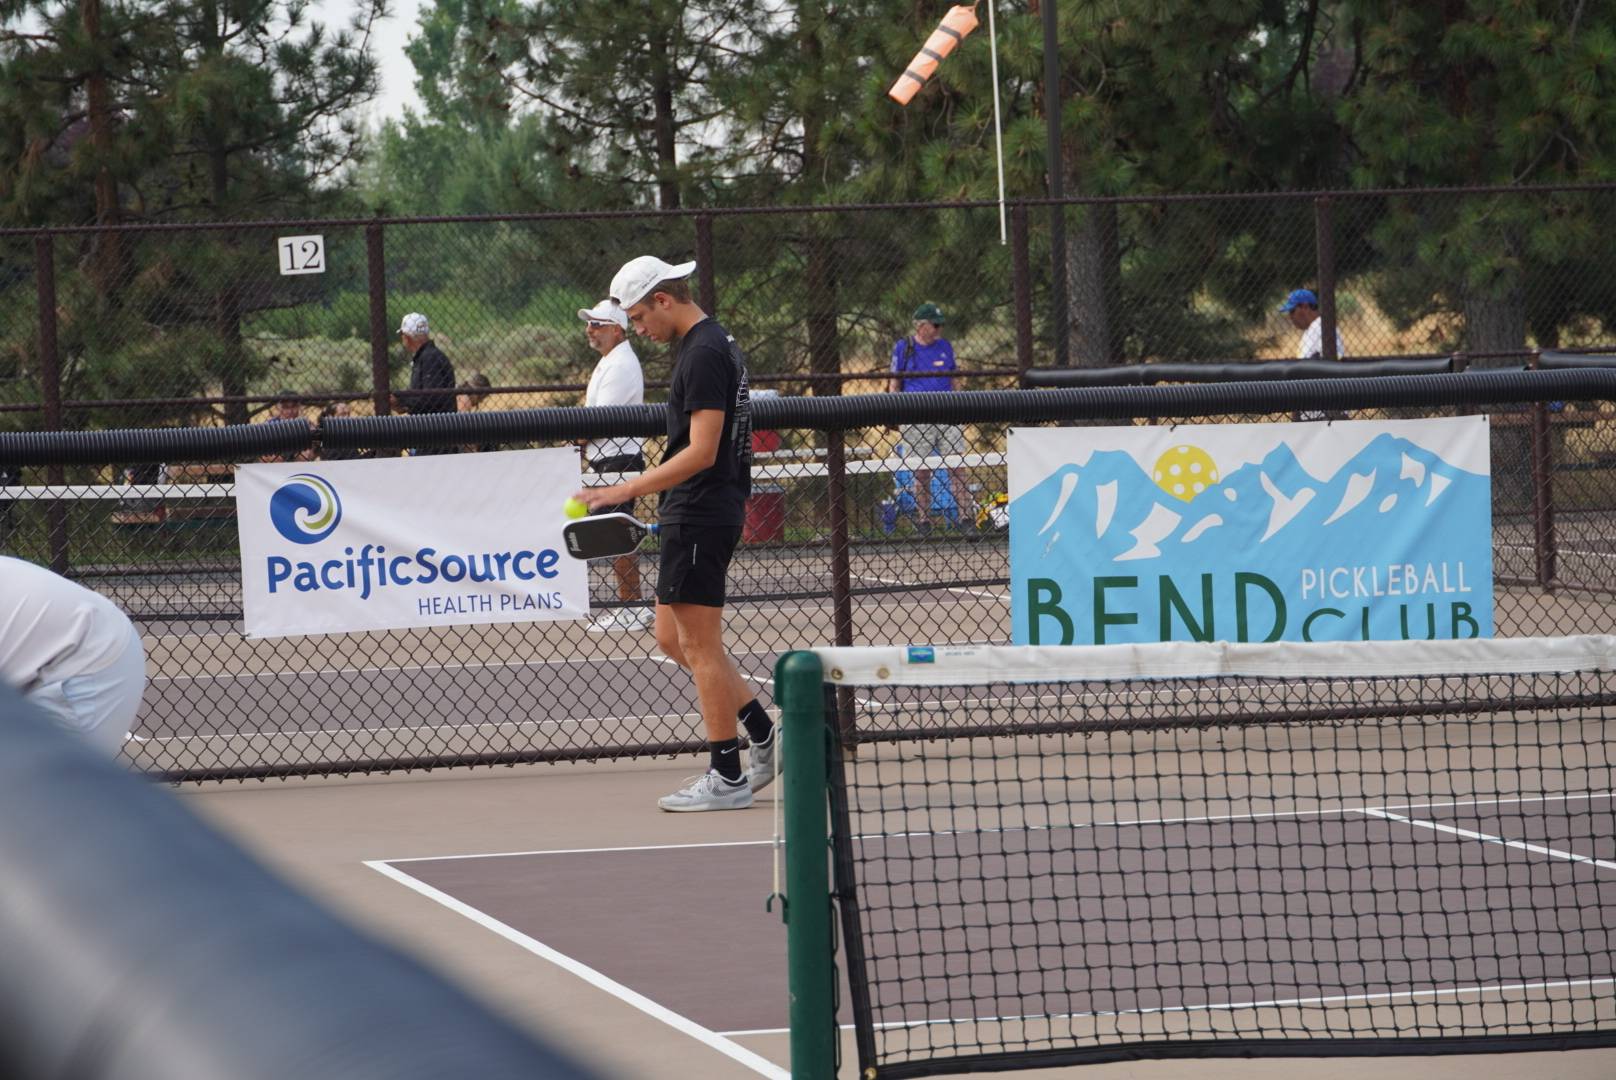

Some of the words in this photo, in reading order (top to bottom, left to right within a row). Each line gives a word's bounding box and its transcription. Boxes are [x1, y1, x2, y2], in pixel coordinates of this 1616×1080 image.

[283, 240, 320, 271] 12
[267, 544, 560, 600] PacificSource
[1302, 561, 1472, 600] PICKLEBALL
[418, 594, 492, 616] HEALTH
[500, 592, 564, 612] PLANS
